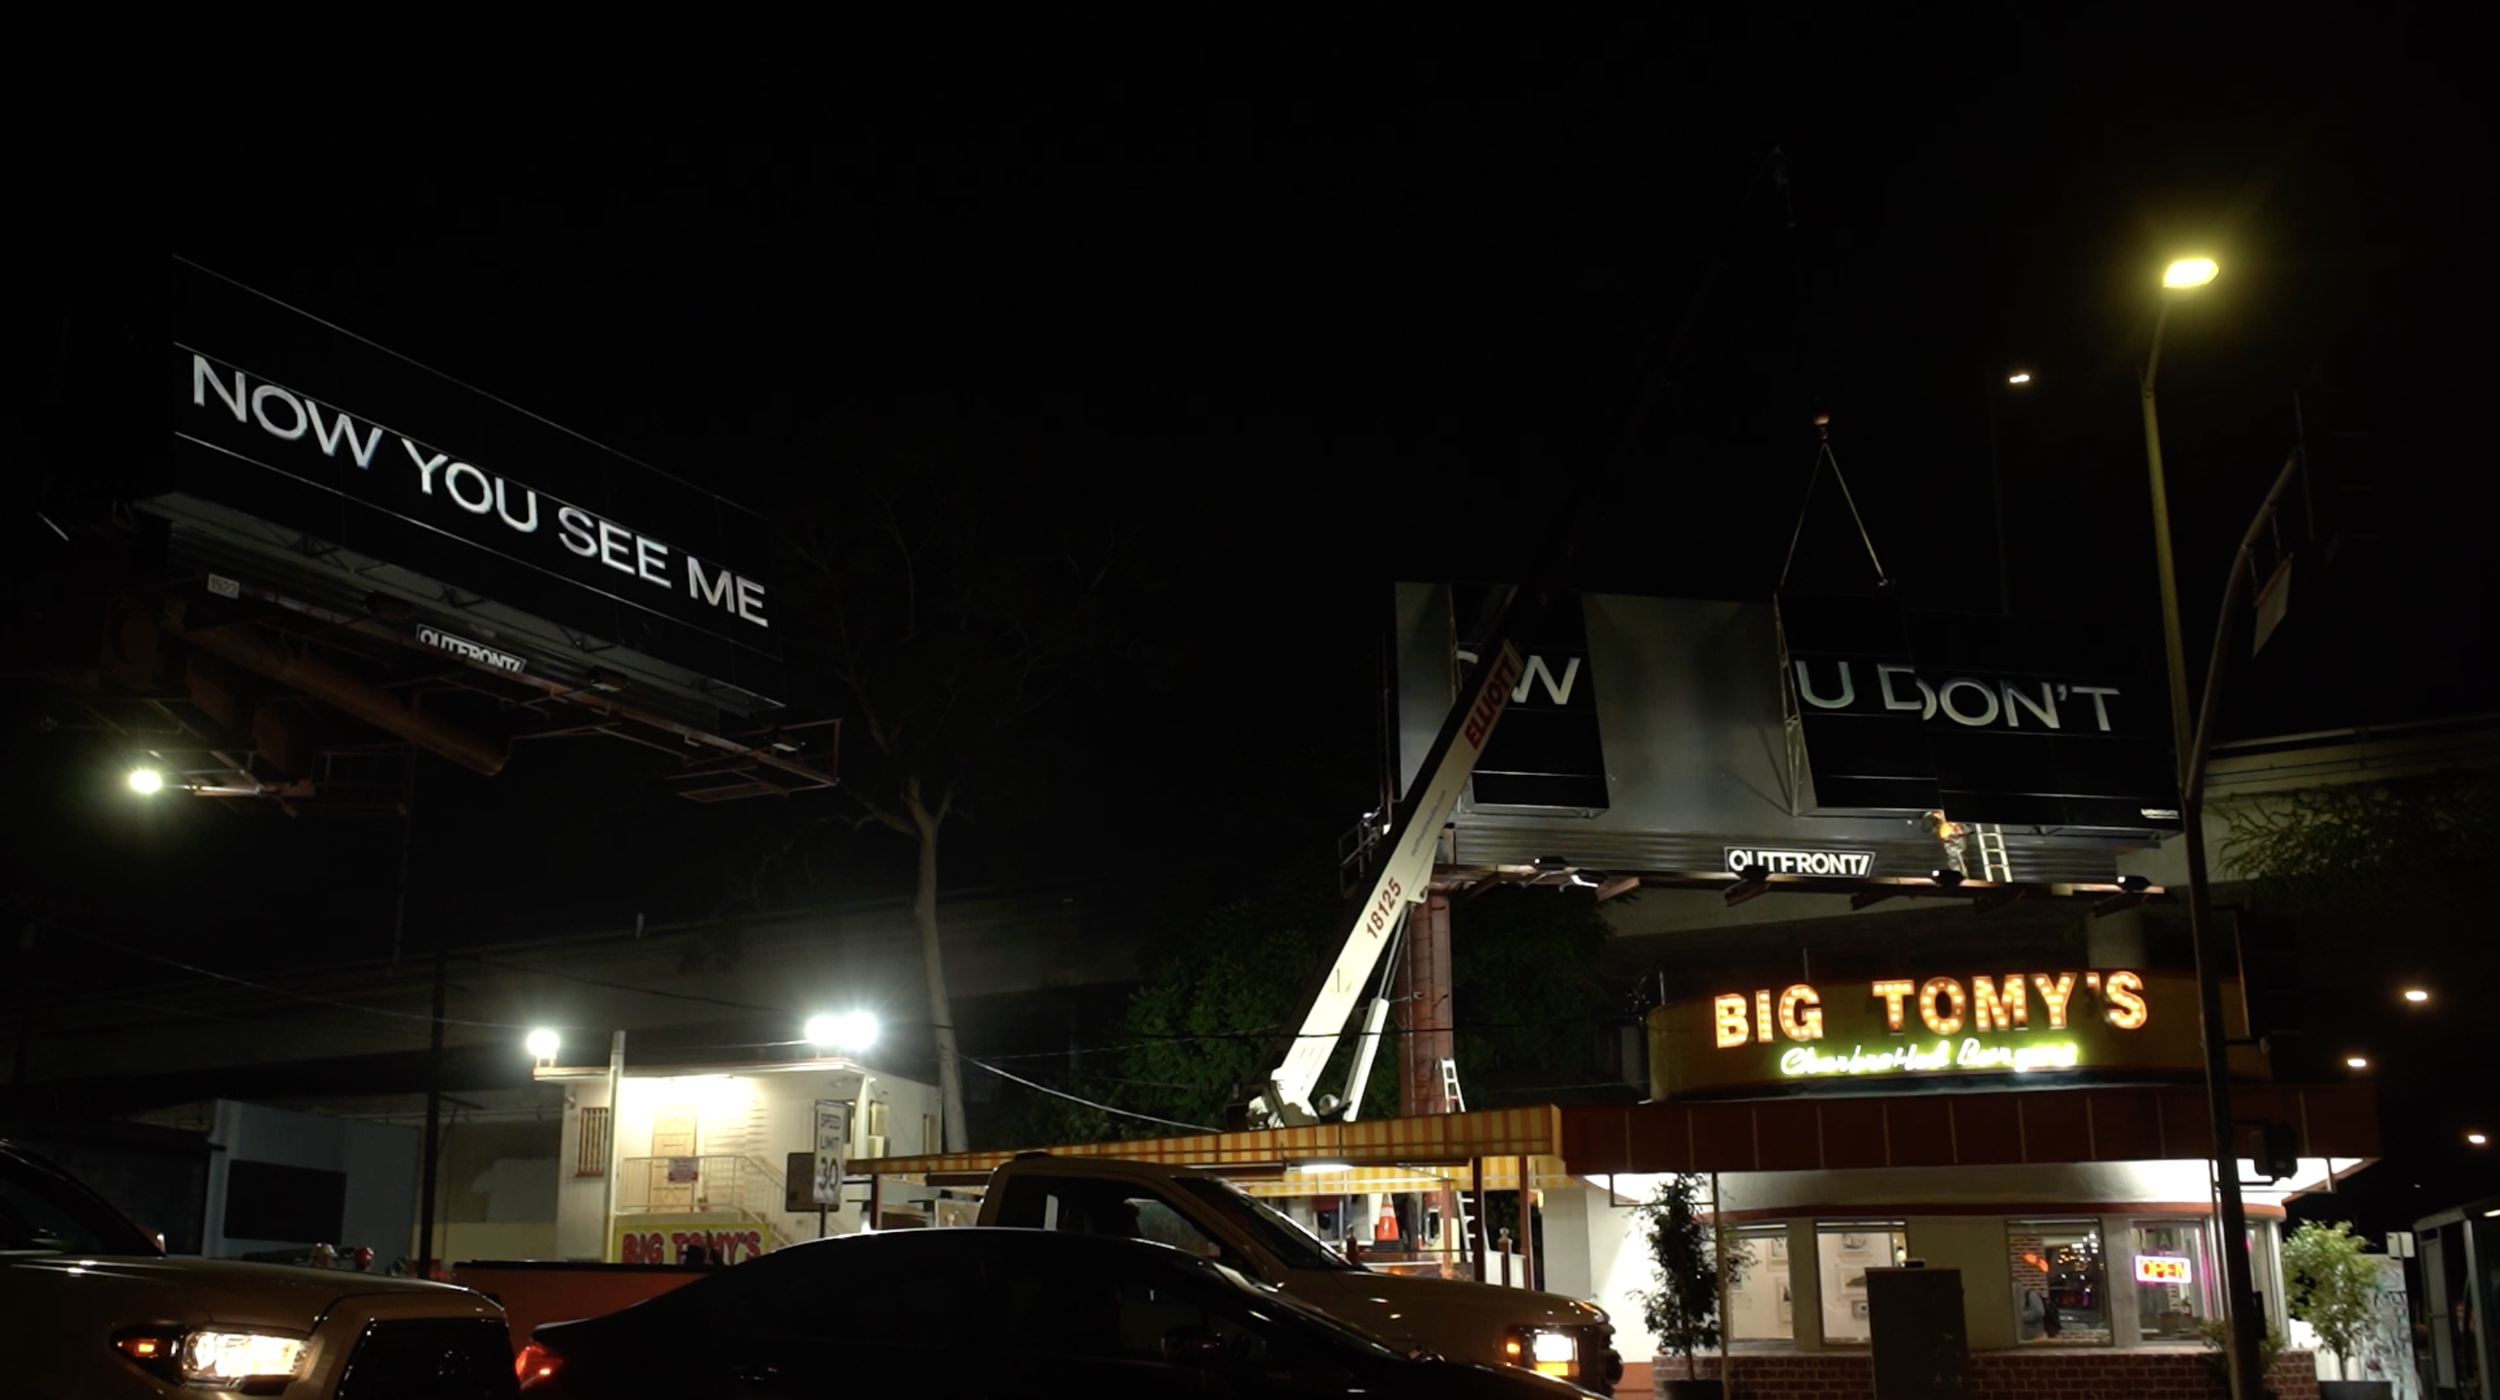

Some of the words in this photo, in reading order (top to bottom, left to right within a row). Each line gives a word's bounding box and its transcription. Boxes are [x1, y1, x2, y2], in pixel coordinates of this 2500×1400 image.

[193, 354, 385, 470] NOW
[399, 437, 540, 534] YOU
[557, 506, 673, 590] SEE
[687, 555, 770, 629] ME
[1464, 655, 1517, 750] ELLIOTT
[1876, 662, 2121, 732] DON'T
[1365, 877, 1401, 939] 18125
[1714, 984, 1824, 1049] BIG
[1872, 971, 2149, 1035] TOMY'S
[820, 1112, 841, 1130] SPEED
[820, 1134, 840, 1151] LIMIT
[818, 1156, 839, 1191] 30
[622, 1232, 665, 1265] BIG
[2140, 1259, 2186, 1279] OPEN
